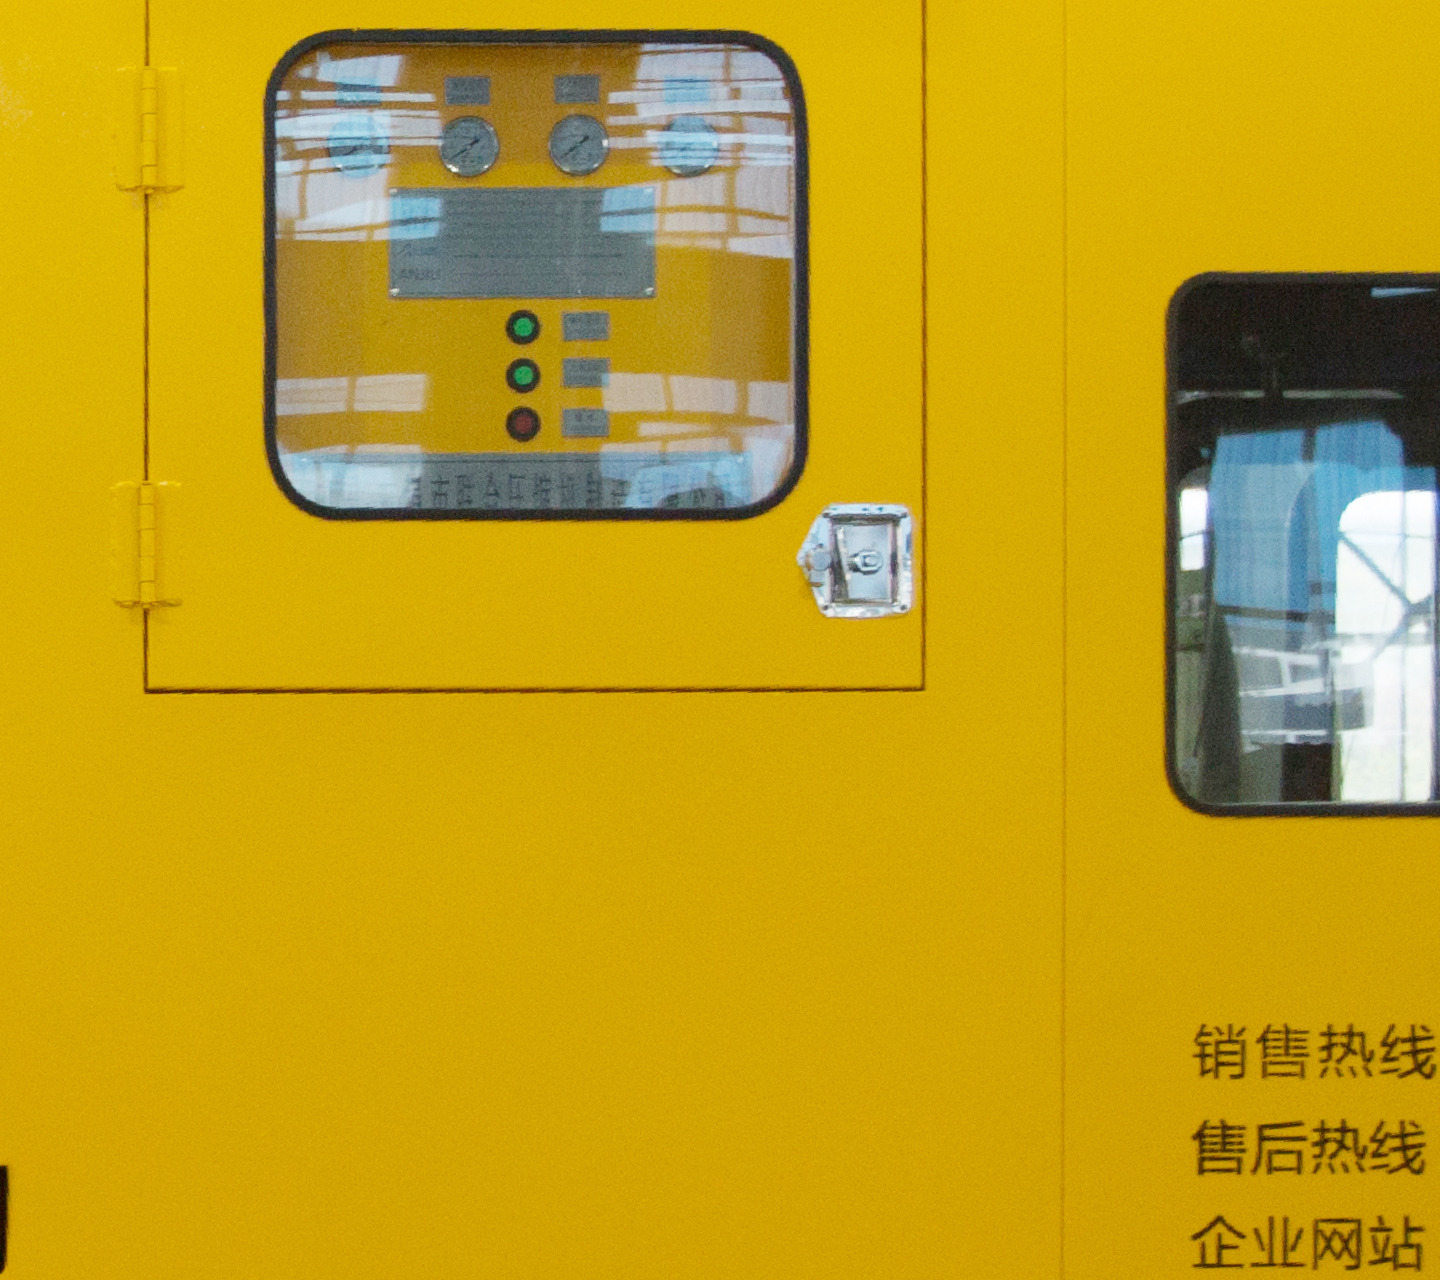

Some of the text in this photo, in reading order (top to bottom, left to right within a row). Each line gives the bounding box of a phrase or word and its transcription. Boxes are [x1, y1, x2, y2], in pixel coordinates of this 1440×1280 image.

[1191, 1023, 1437, 1081] 销售热线
[1190, 1119, 1426, 1176] 售后热线
[1190, 1214, 1425, 1272] 企业网站
